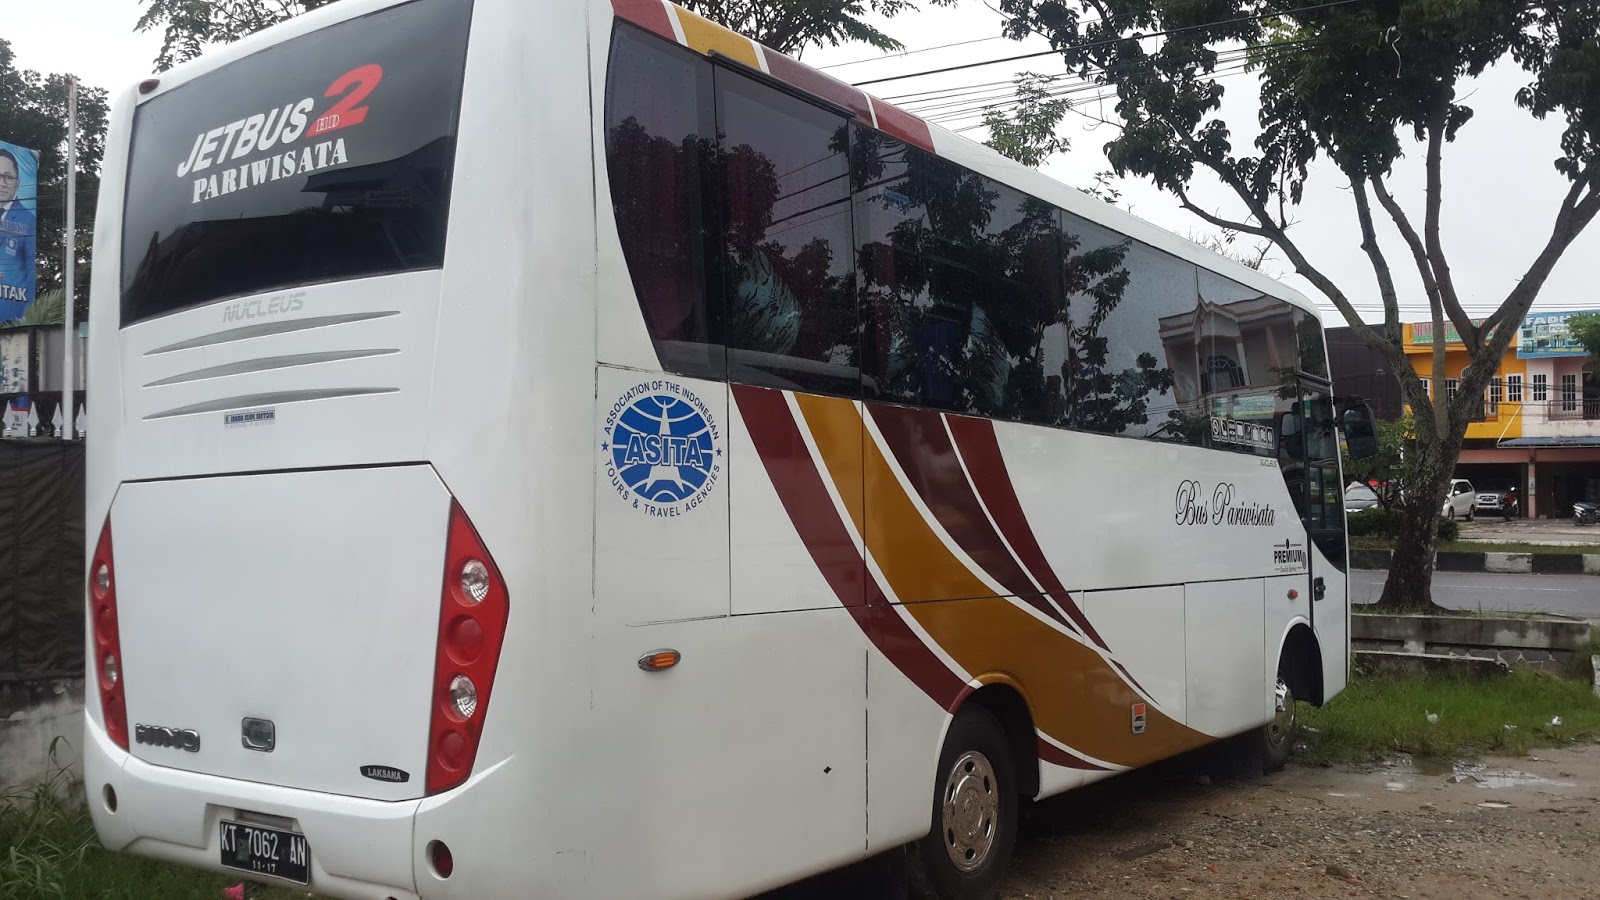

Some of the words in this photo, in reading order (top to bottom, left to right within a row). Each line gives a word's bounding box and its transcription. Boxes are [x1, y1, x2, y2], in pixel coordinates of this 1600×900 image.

[176, 97, 315, 178] JETBUS
[305, 63, 383, 138] 2
[192, 138, 348, 204] PARIWISATA
[223, 292, 306, 324] NUCLEUS
[604, 381, 650, 436] ASSOCIATION
[651, 380, 663, 391] OF
[665, 381, 681, 394] THE
[682, 388, 720, 441] INDONESIAN
[624, 433, 704, 467] ASITA
[605, 458, 630, 501] TOURS
[632, 498, 639, 509] &
[644, 503, 681, 518] TRAVEL
[685, 465, 720, 513] AGENCIES
[1175, 479, 1208, 526] Bus
[1212, 482, 1275, 526] Pariwisata
[1274, 550, 1302, 564] PREMIUM
[367, 767, 402, 781] LAKSANA
[221, 823, 237, 852] KT
[245, 828, 279, 861] 7062
[290, 836, 306, 867] AN
